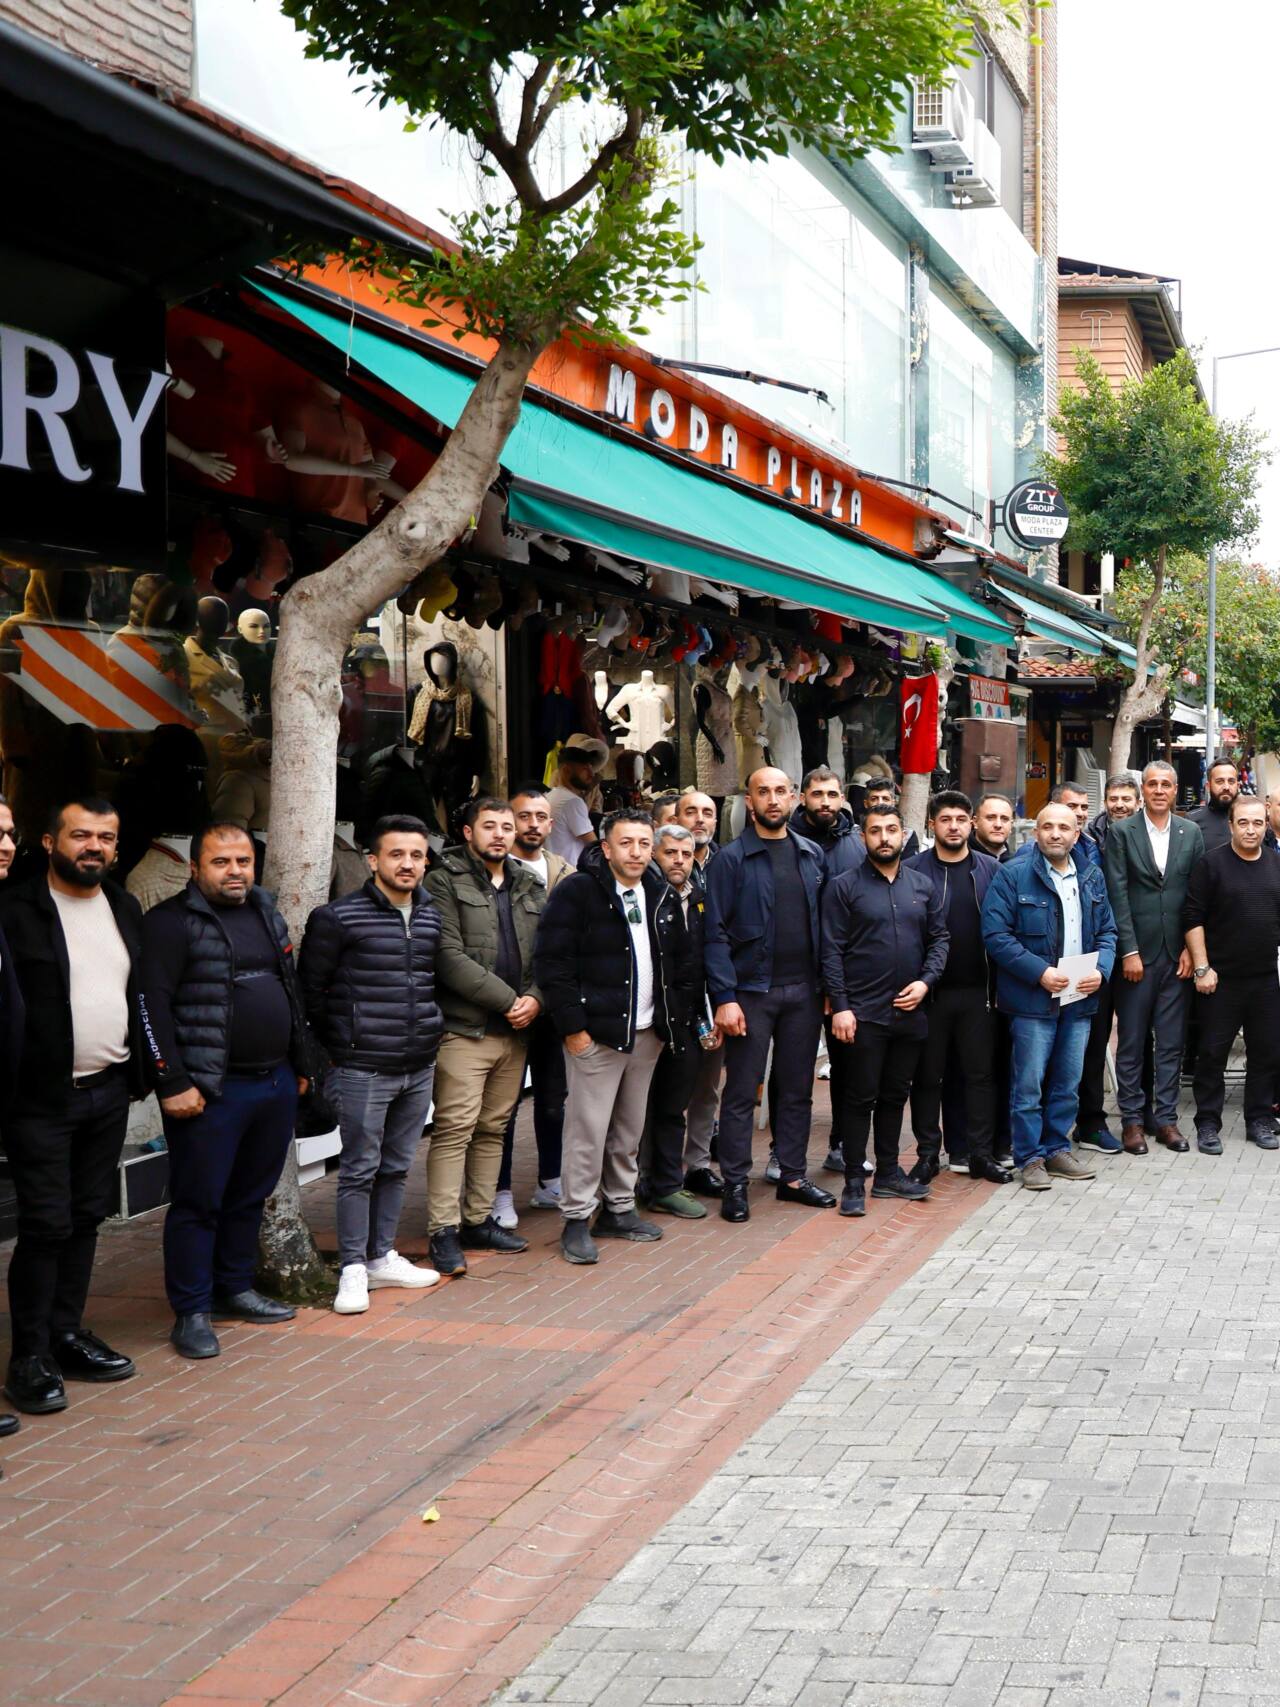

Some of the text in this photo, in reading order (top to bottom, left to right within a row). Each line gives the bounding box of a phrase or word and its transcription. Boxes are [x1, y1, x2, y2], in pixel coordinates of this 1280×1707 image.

[606, 363, 862, 526] MODA PLAZA
[1026, 489, 1058, 505] ZTY
[1027, 503, 1055, 513] GROUP
[1021, 515, 1063, 527] MODA PLAZA
[1029, 526, 1055, 536] CENTER
